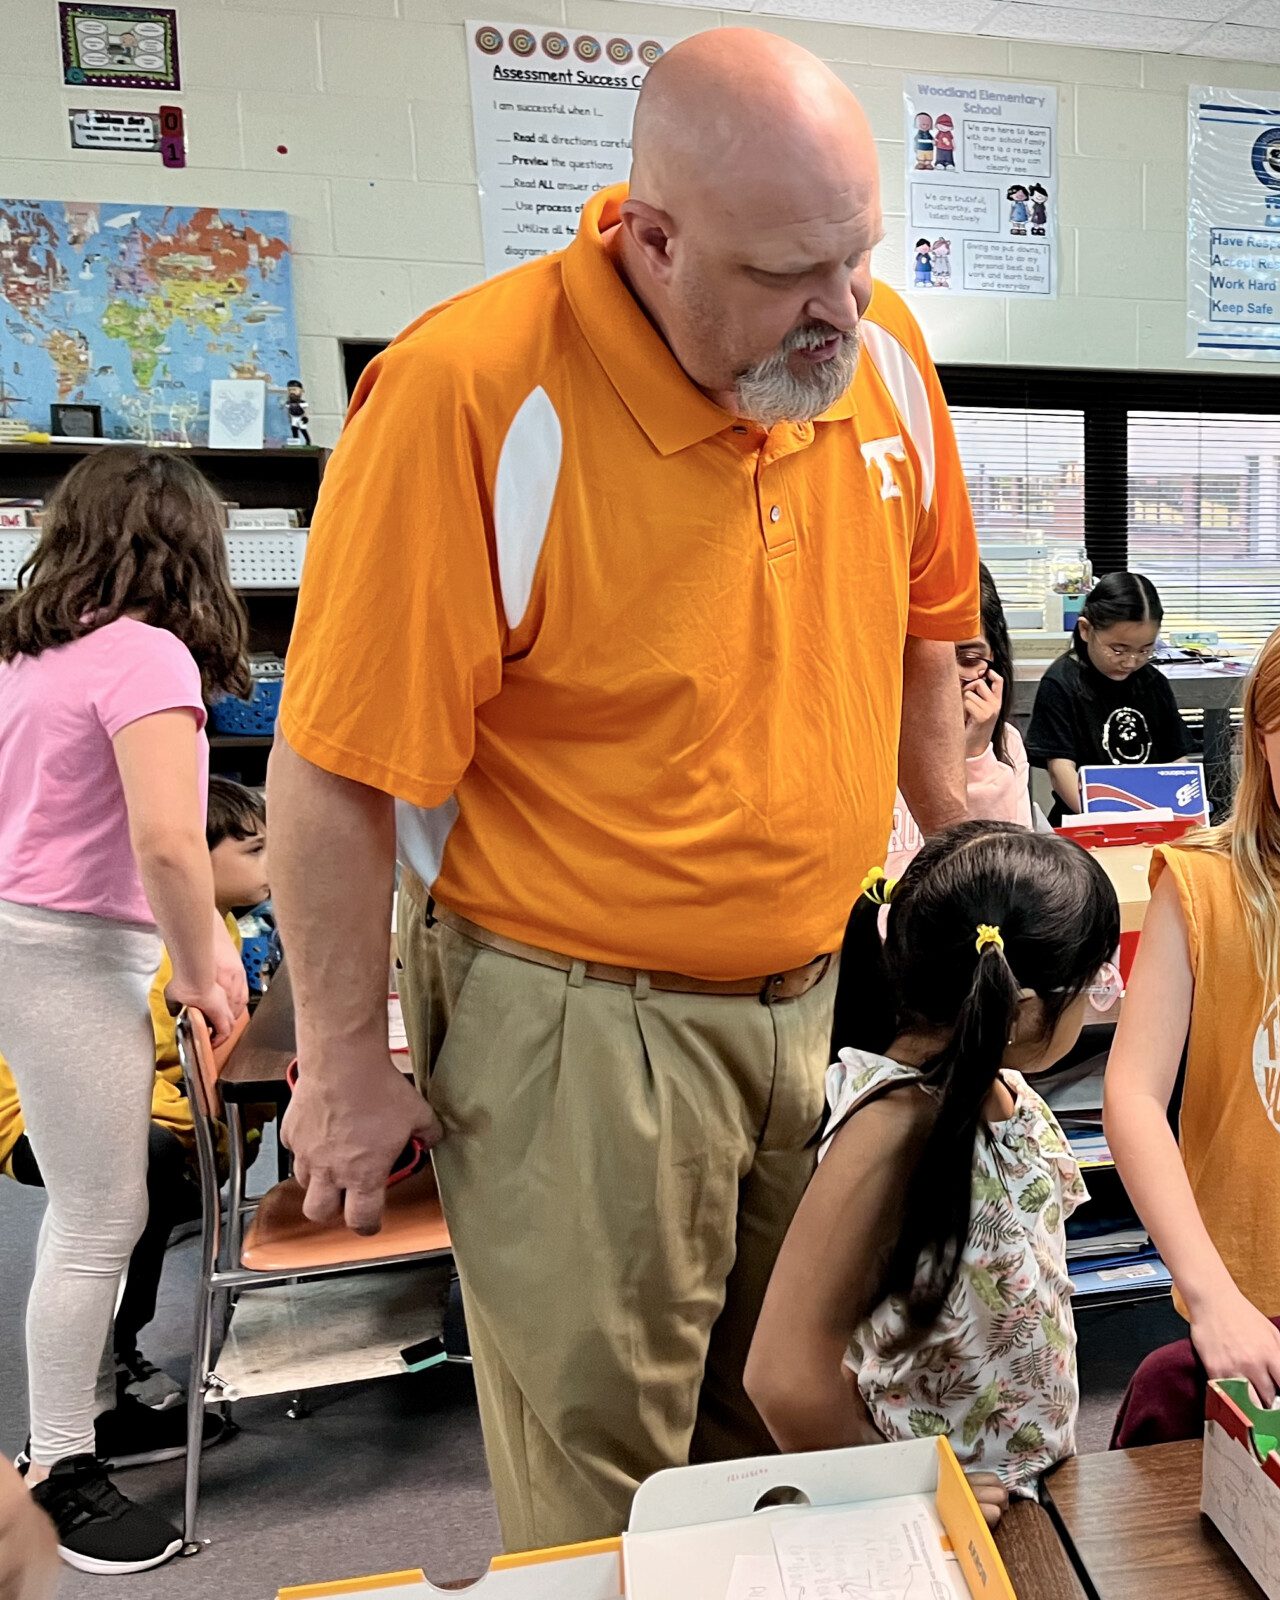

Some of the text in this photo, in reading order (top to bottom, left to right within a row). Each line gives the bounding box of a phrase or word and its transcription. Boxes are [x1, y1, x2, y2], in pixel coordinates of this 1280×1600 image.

[494, 64, 573, 83] Assessment
[577, 70, 627, 87] Success
[918, 84, 1045, 107] Woodland Elementary
[517, 103, 566, 114] successful
[568, 105, 590, 115] when
[963, 103, 1002, 115] School
[998, 126, 1014, 135] here
[513, 132, 535, 143] Read
[538, 134, 549, 144] all
[552, 134, 598, 147] directions
[1000, 135, 1022, 144] school
[512, 155, 613, 171] Preview the questions
[514, 178, 535, 188] Read
[538, 179, 554, 190] ALL
[557, 183, 588, 191] answer
[516, 201, 532, 210] Use
[536, 203, 572, 214] process
[517, 224, 549, 234] Utilize
[552, 225, 563, 234] all
[1212, 233, 1243, 246] Have
[1211, 276, 1276, 291] Work Hard
[1212, 300, 1273, 315] Keep Safe
